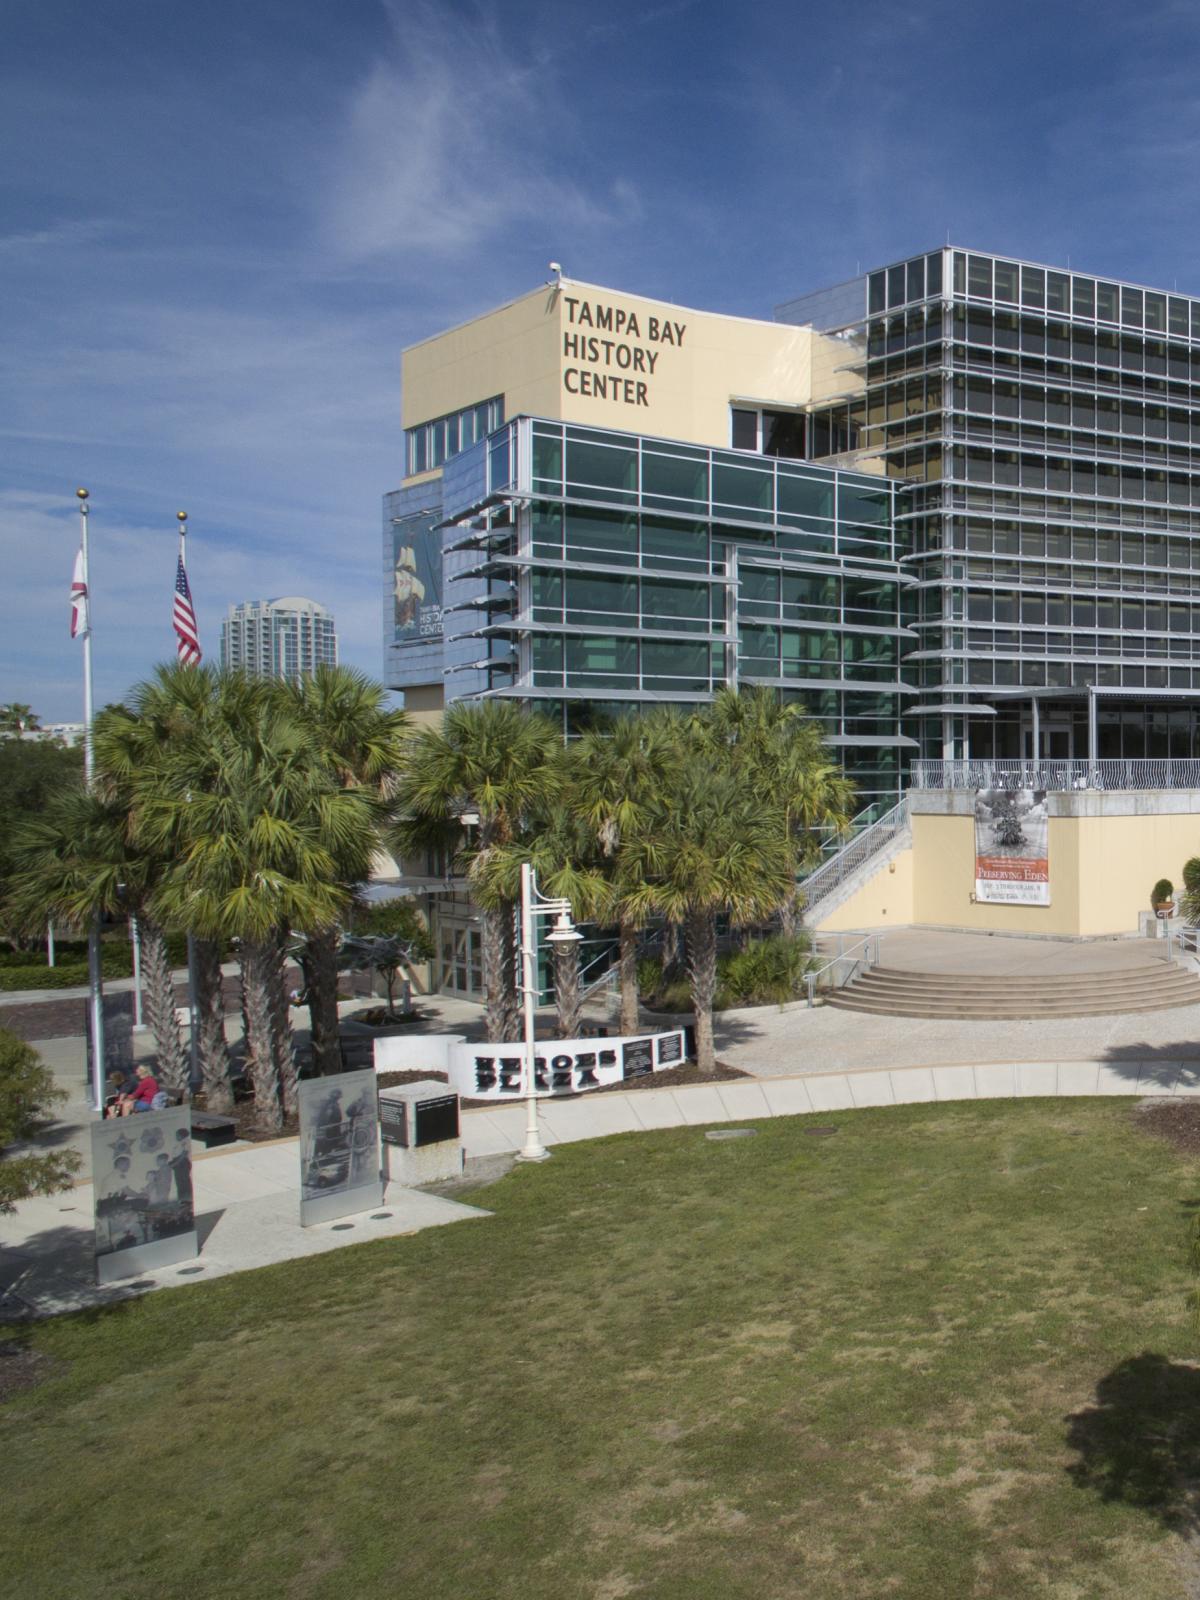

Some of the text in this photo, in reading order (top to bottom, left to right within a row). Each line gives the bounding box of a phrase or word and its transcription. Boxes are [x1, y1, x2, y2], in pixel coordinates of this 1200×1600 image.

[564, 297, 687, 347] TAMPA BAY
[564, 332, 659, 375] HISTORY
[564, 368, 649, 407] CENTER
[978, 867, 1048, 881] PRESERVING EDEN
[474, 1049, 617, 1073] HEROES
[475, 1070, 600, 1093] PLAZA
